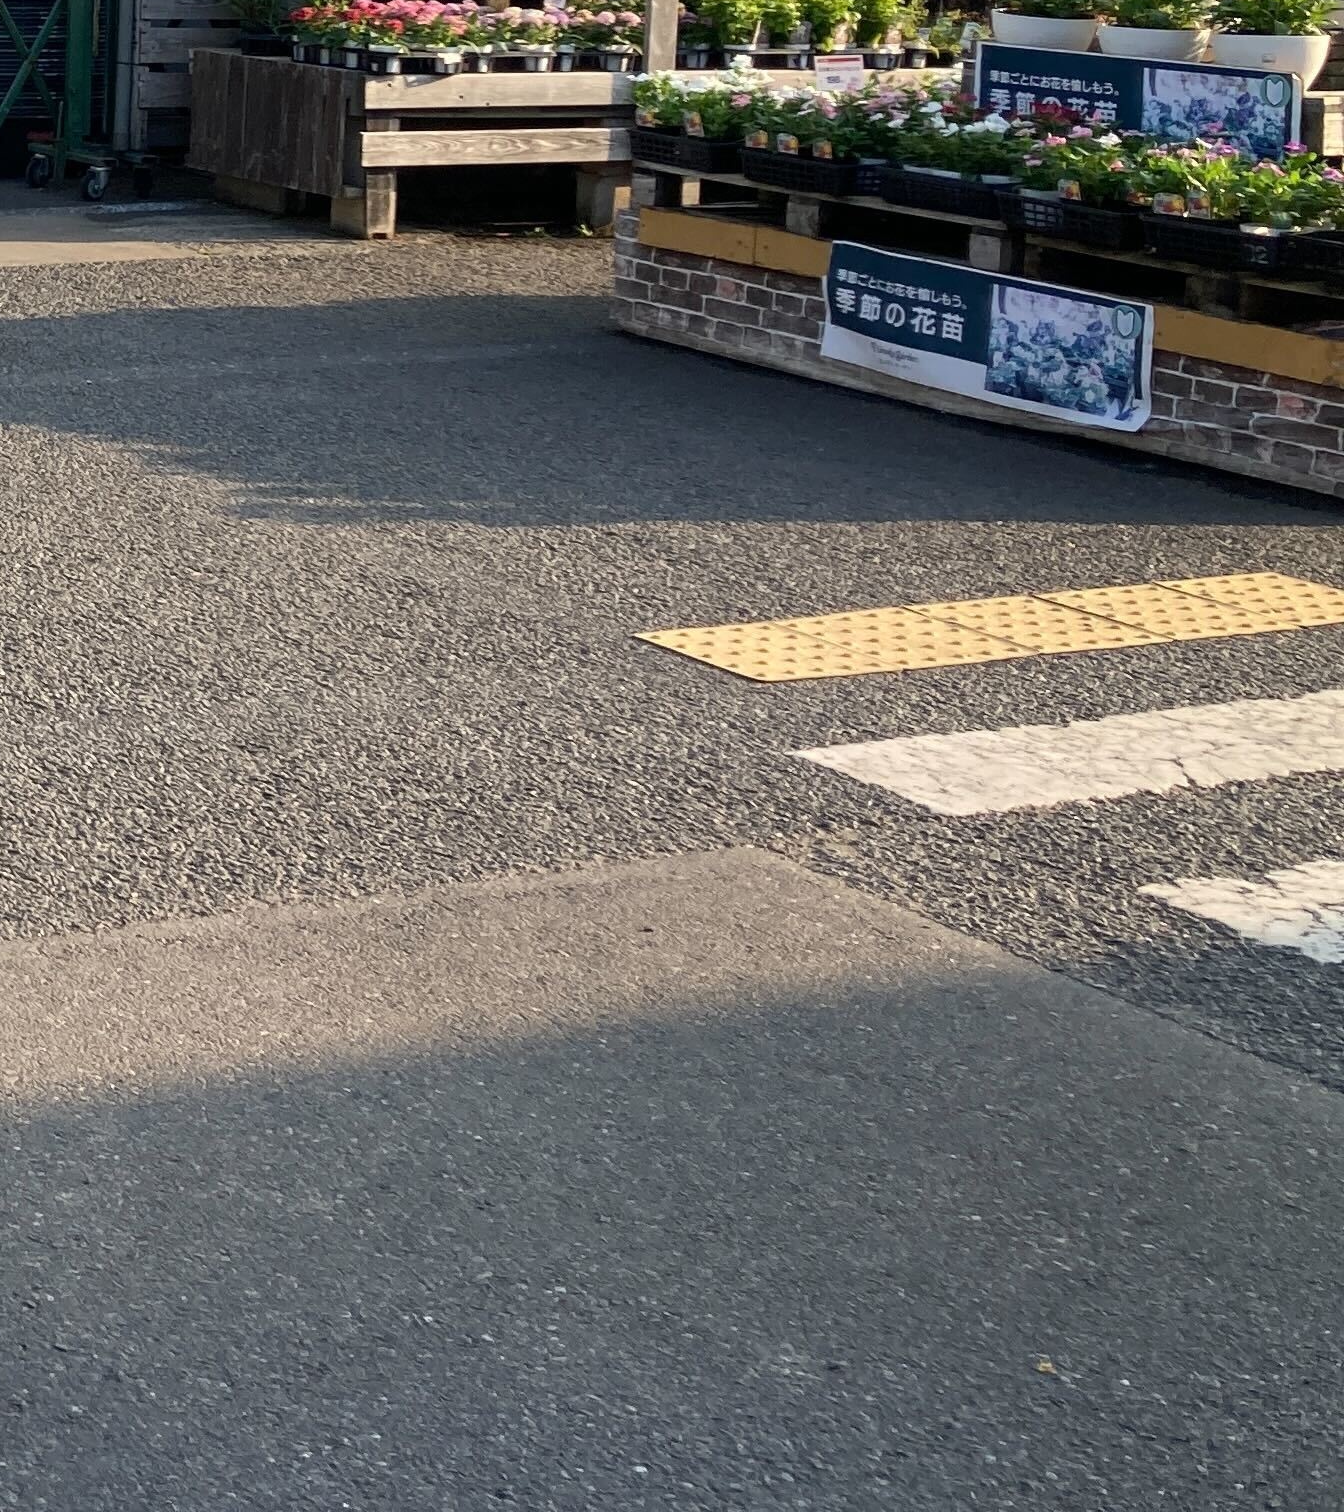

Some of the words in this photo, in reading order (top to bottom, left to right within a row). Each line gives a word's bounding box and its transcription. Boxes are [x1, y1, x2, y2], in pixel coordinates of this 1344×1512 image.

[834, 287, 965, 343] 季節の花苗
